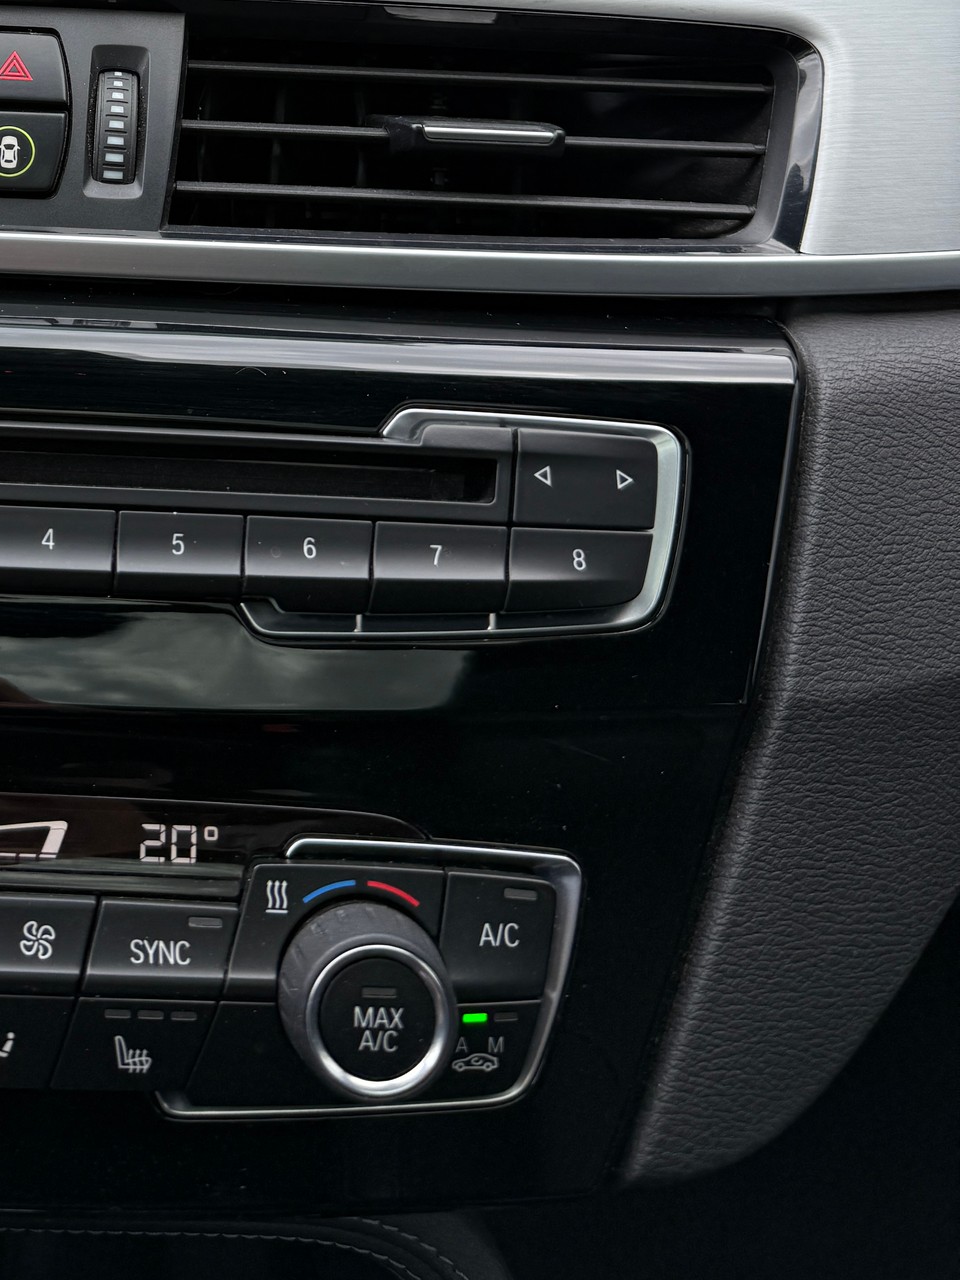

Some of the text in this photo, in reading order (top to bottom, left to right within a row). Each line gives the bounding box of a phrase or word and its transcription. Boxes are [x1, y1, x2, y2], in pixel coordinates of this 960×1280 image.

[41, 528, 55, 550] 4
[171, 533, 185, 555] 5
[302, 537, 316, 559] 6
[429, 544, 443, 566] 7
[572, 548, 586, 571] 8
[479, 923, 520, 947] A/C
[130, 939, 191, 966] SYNC
[354, 1007, 404, 1029] MAX
[358, 1030, 398, 1053] A/C
[456, 1037, 468, 1053] A
[488, 1036, 504, 1053] M
